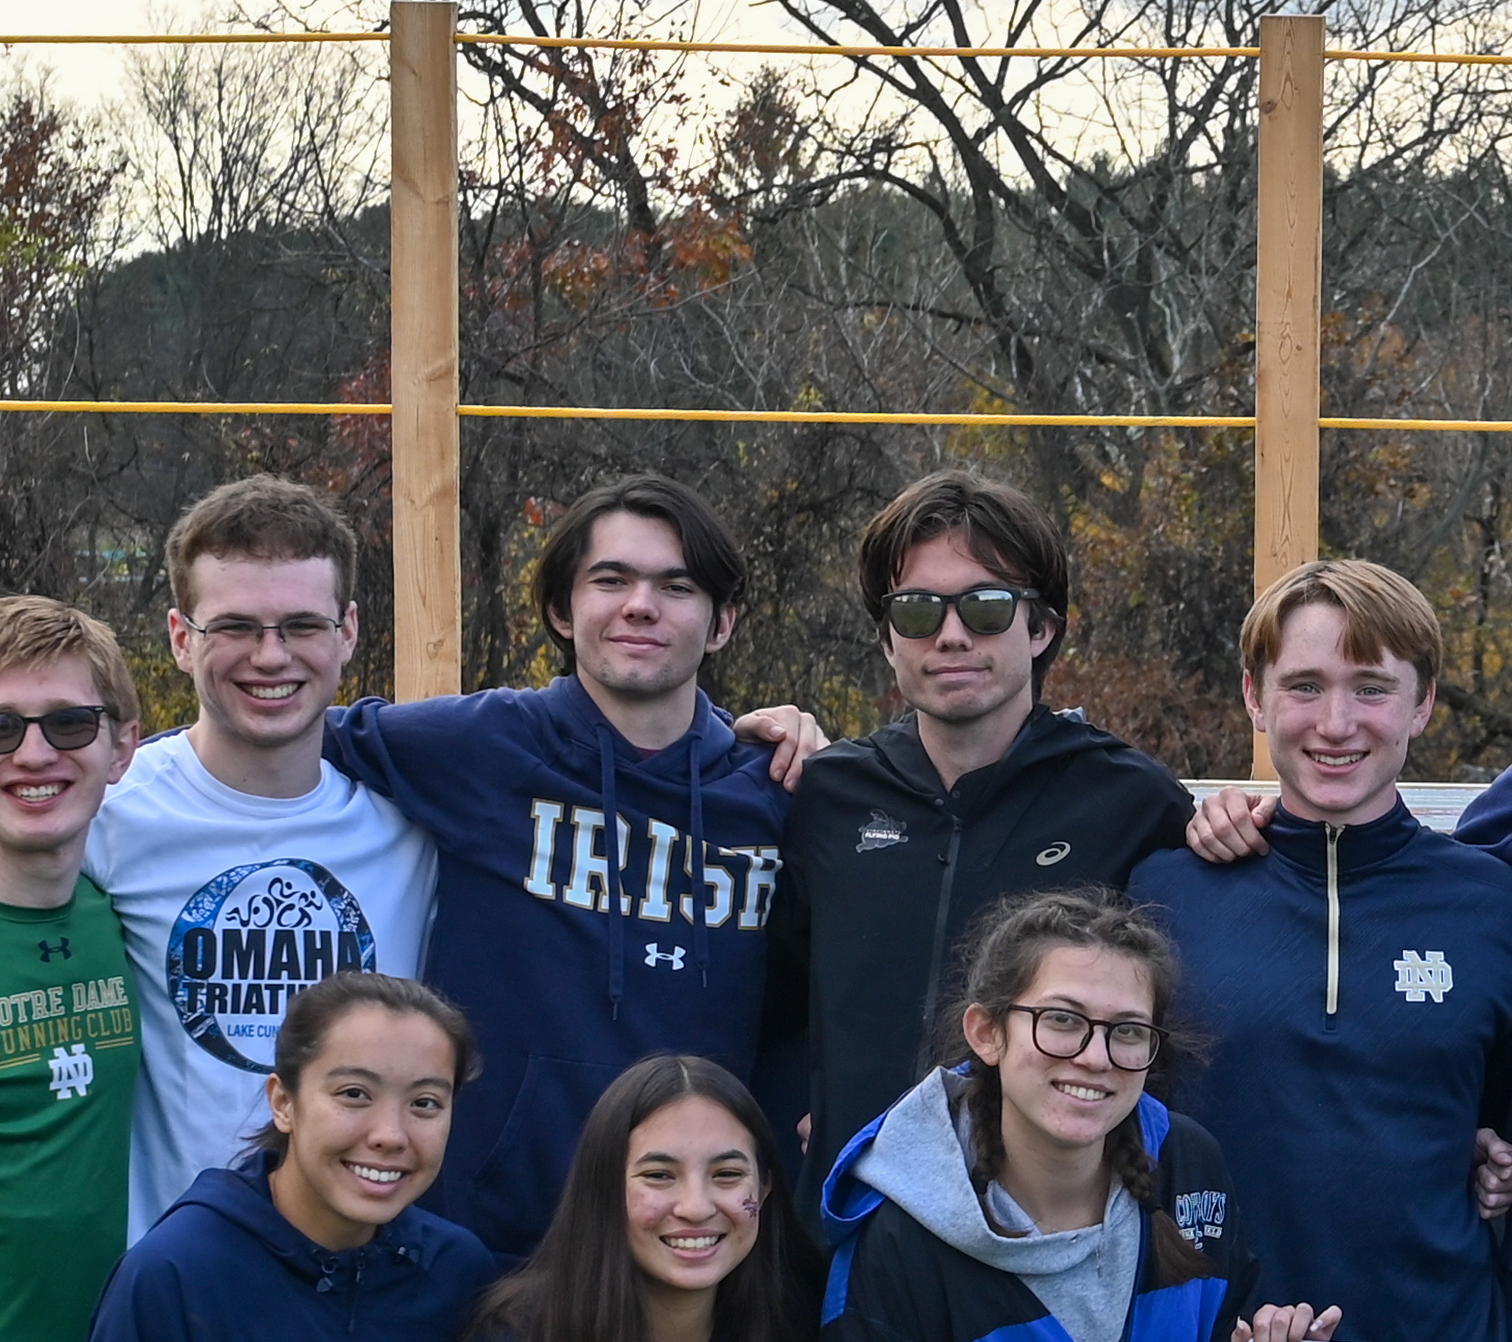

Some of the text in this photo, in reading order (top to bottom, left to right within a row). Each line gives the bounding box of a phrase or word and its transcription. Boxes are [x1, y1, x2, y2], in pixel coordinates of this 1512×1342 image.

[523, 797, 783, 930] IRISH
[182, 927, 363, 981] OMAHA
[71, 976, 129, 1013] DAME
[182, 982, 314, 1015] TRIAT
[87, 1008, 133, 1038] CLUB
[227, 1024, 254, 1037] LAKE
